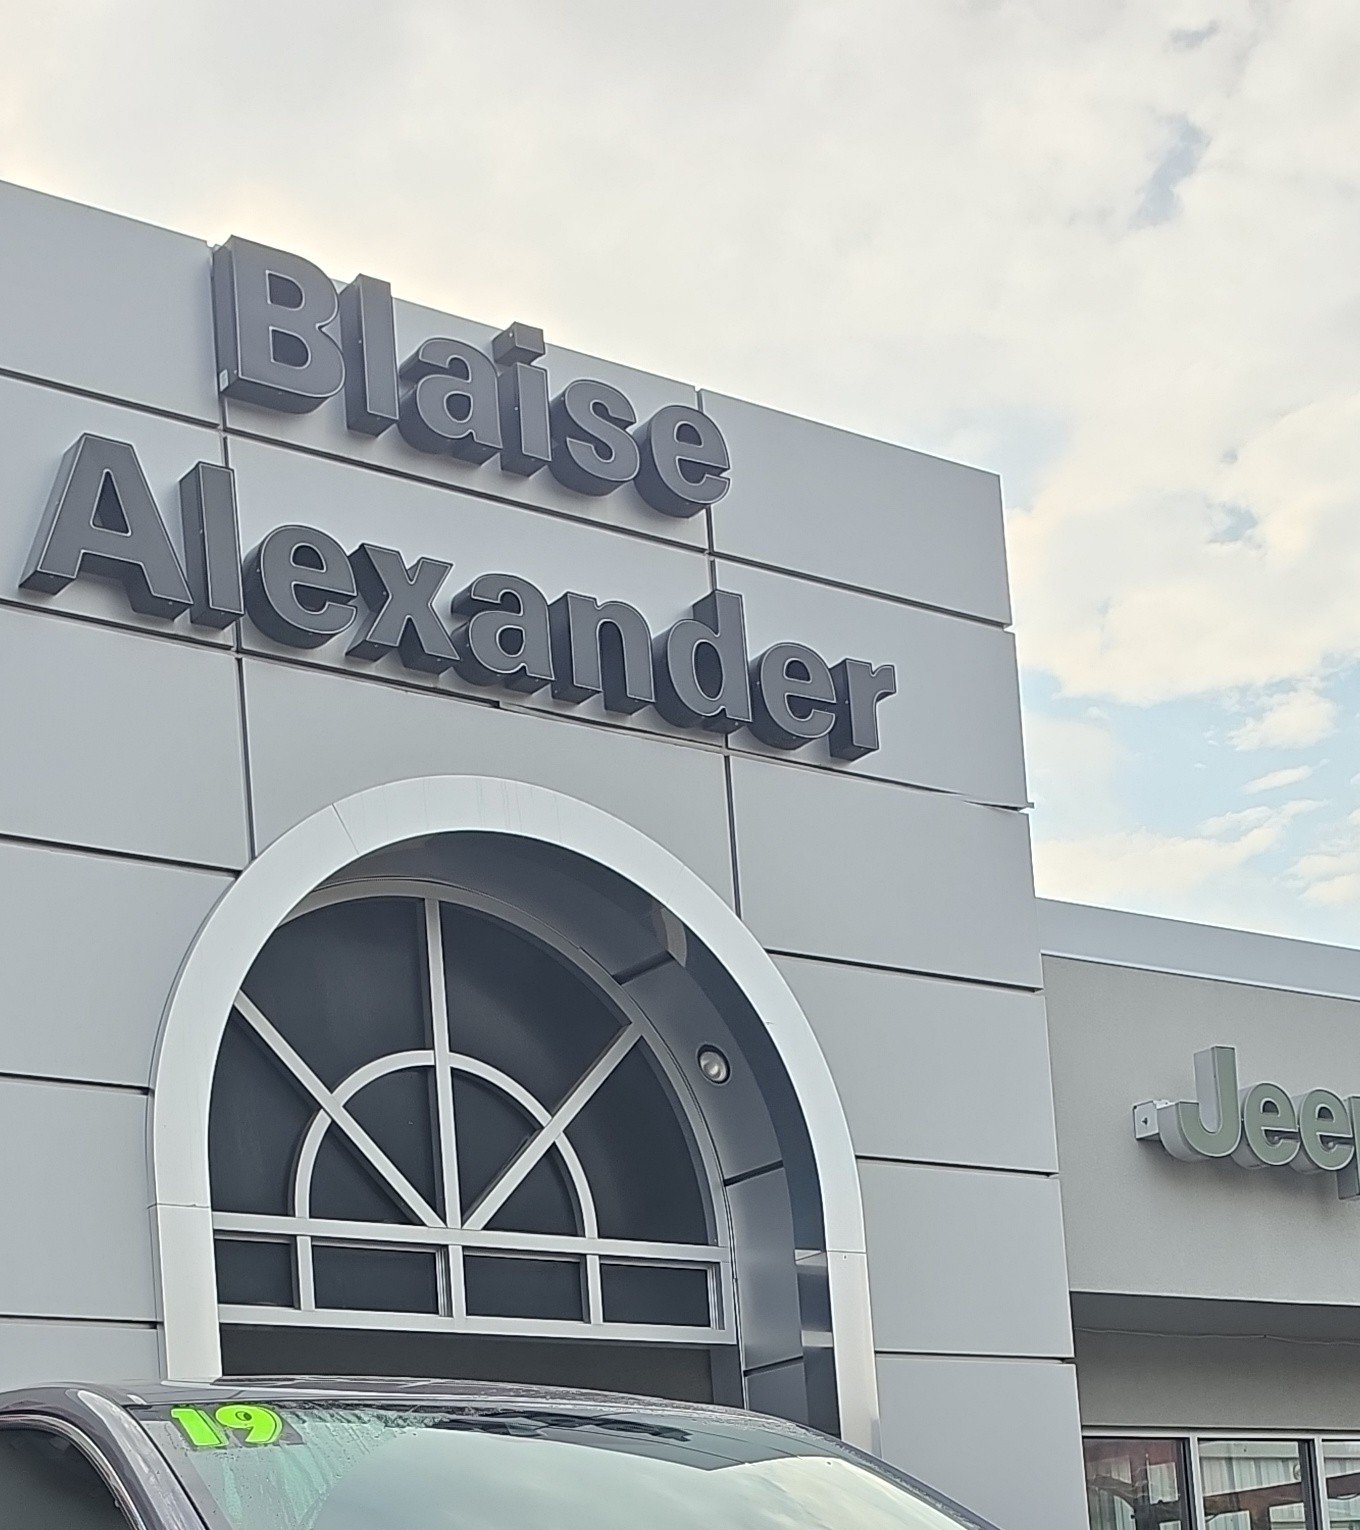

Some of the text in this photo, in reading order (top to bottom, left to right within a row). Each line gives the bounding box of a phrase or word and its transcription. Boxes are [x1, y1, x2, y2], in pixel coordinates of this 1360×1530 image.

[213, 236, 732, 518] Blaise
[19, 433, 897, 760] Alexander
[171, 1405, 283, 1447] 19
